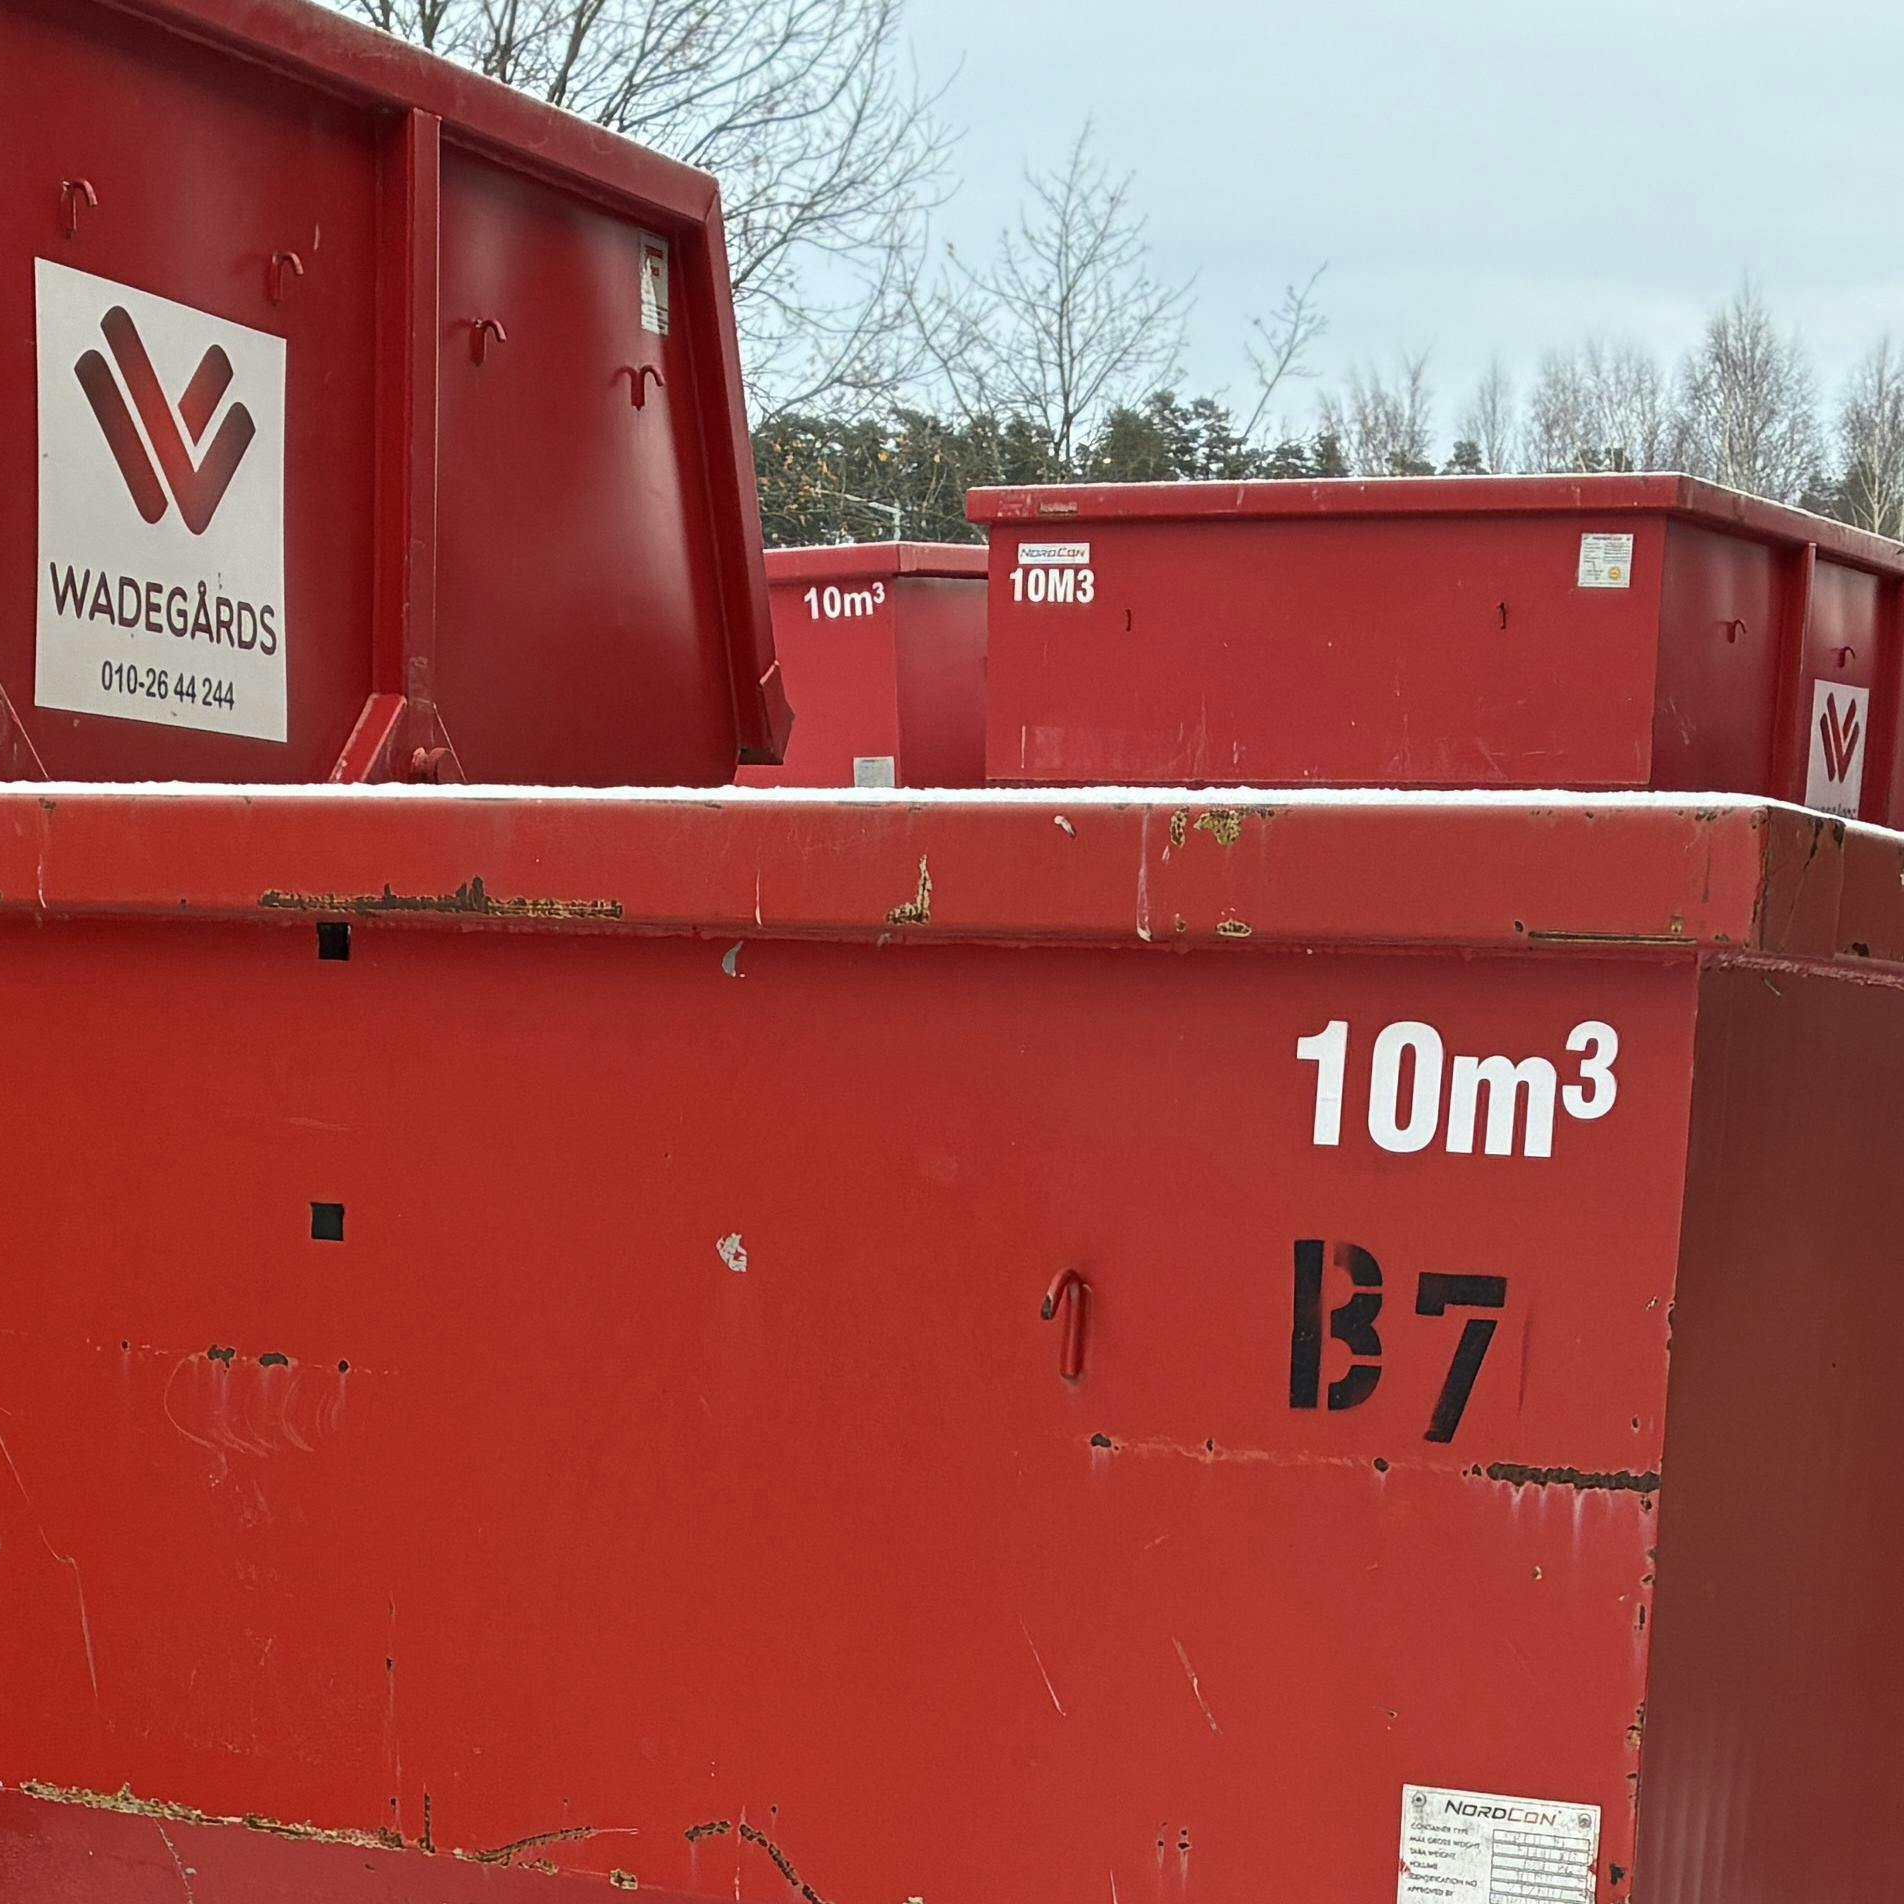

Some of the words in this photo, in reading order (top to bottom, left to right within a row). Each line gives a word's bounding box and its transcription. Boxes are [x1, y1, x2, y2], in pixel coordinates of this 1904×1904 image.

[50, 562, 277, 656] WADEGÅRDS
[1010, 567, 1095, 603] 10M3
[101, 660, 169, 699] 010-26
[173, 673, 197, 703] 44
[202, 677, 235, 710] 244
